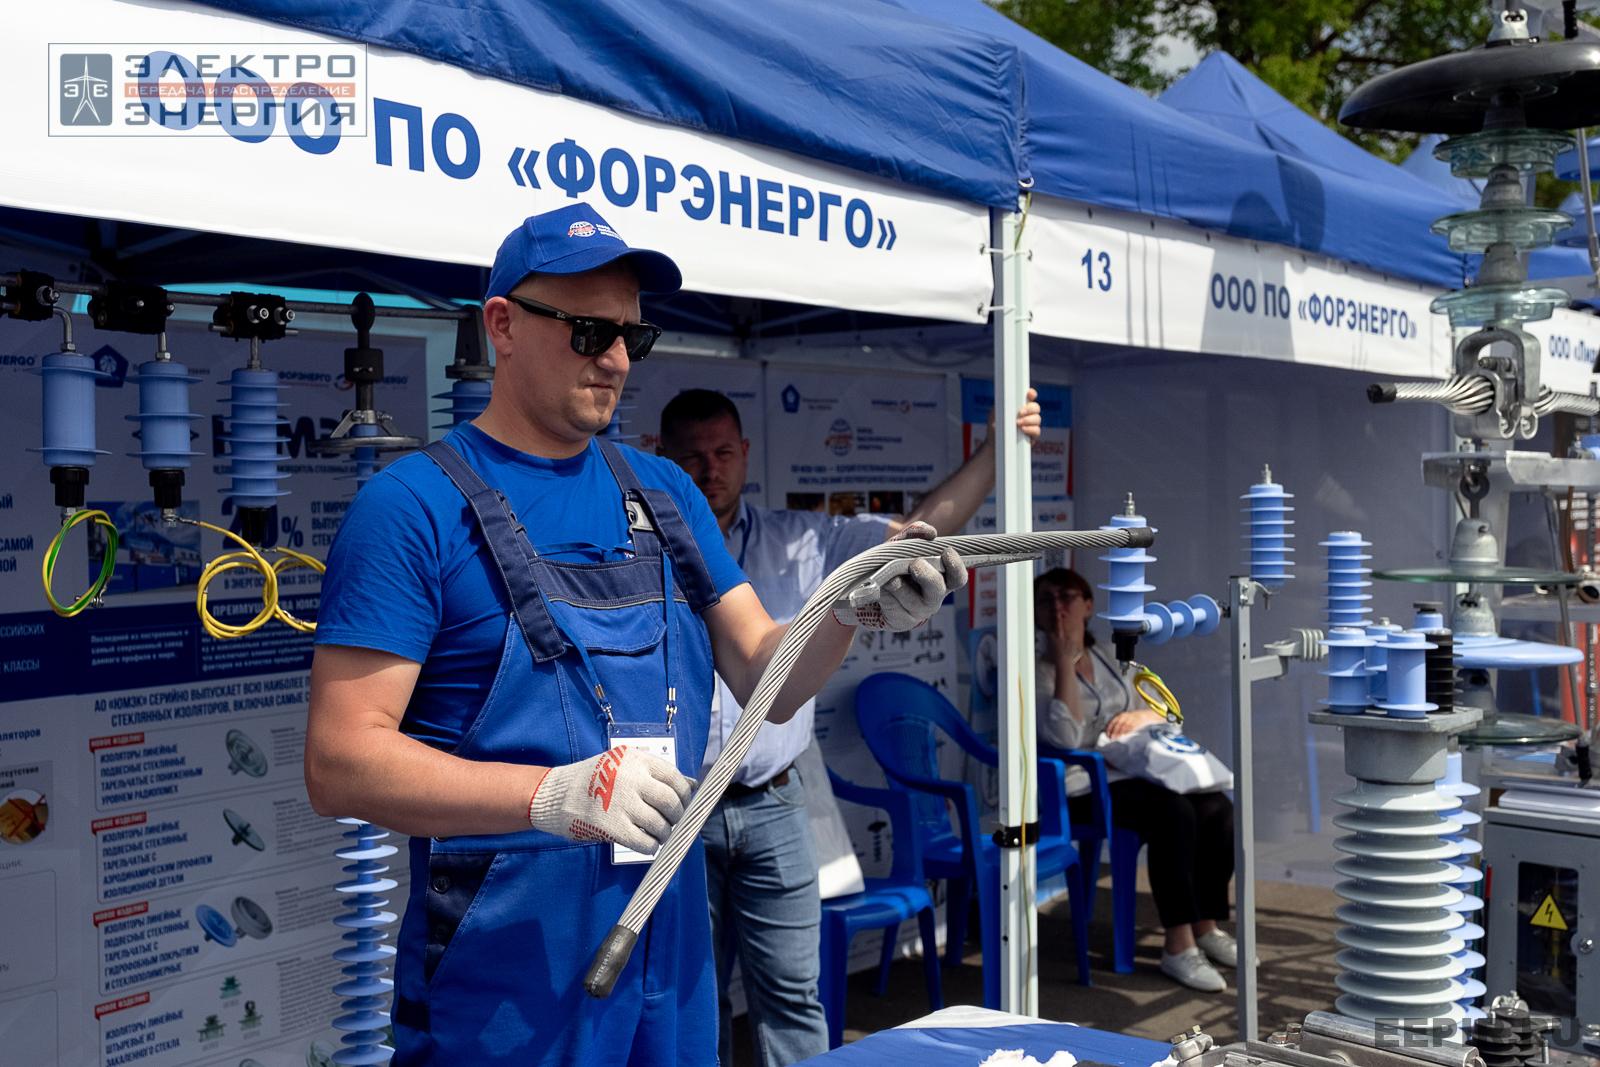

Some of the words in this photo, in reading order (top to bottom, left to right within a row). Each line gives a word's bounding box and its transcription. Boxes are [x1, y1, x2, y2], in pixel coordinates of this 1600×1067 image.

[138, 50, 342, 155] ООО
[373, 97, 481, 180] ПО
[508, 138, 897, 251] «ФОРЭНЕРГО»
[1081, 248, 1112, 292] 13
[1211, 273, 1257, 314] ООО
[1263, 283, 1291, 319] ПО
[1298, 292, 1417, 339] «ФОРЭНЕРГО»
[1549, 335, 1571, 359] ООО
[149, 688, 189, 706] СЕРИЙНО
[191, 684, 242, 701] ВЫПУСКАЕТ
[264, 677, 304, 692] НАИБОЛЕЕ
[111, 707, 173, 728] СТЕКЛЯННЫХ
[100, 750, 142, 764] ИЗОЛЯТОРЫ
[102, 828, 143, 843] ИЗОЛЯТОРЫ
[144, 821, 180, 836] ЛИНЕЙНЫЕ
[104, 919, 145, 935] ИЗОЛЯТОРЫ
[146, 908, 182, 924] ЛИНЕЙНЫЕ
[159, 945, 199, 962] ПОКРЫТИЕМ
[105, 1021, 147, 1041] ИЗОЛЯТОРЫ
[147, 1009, 183, 1029] ЛИНЕЙНЫЕ
